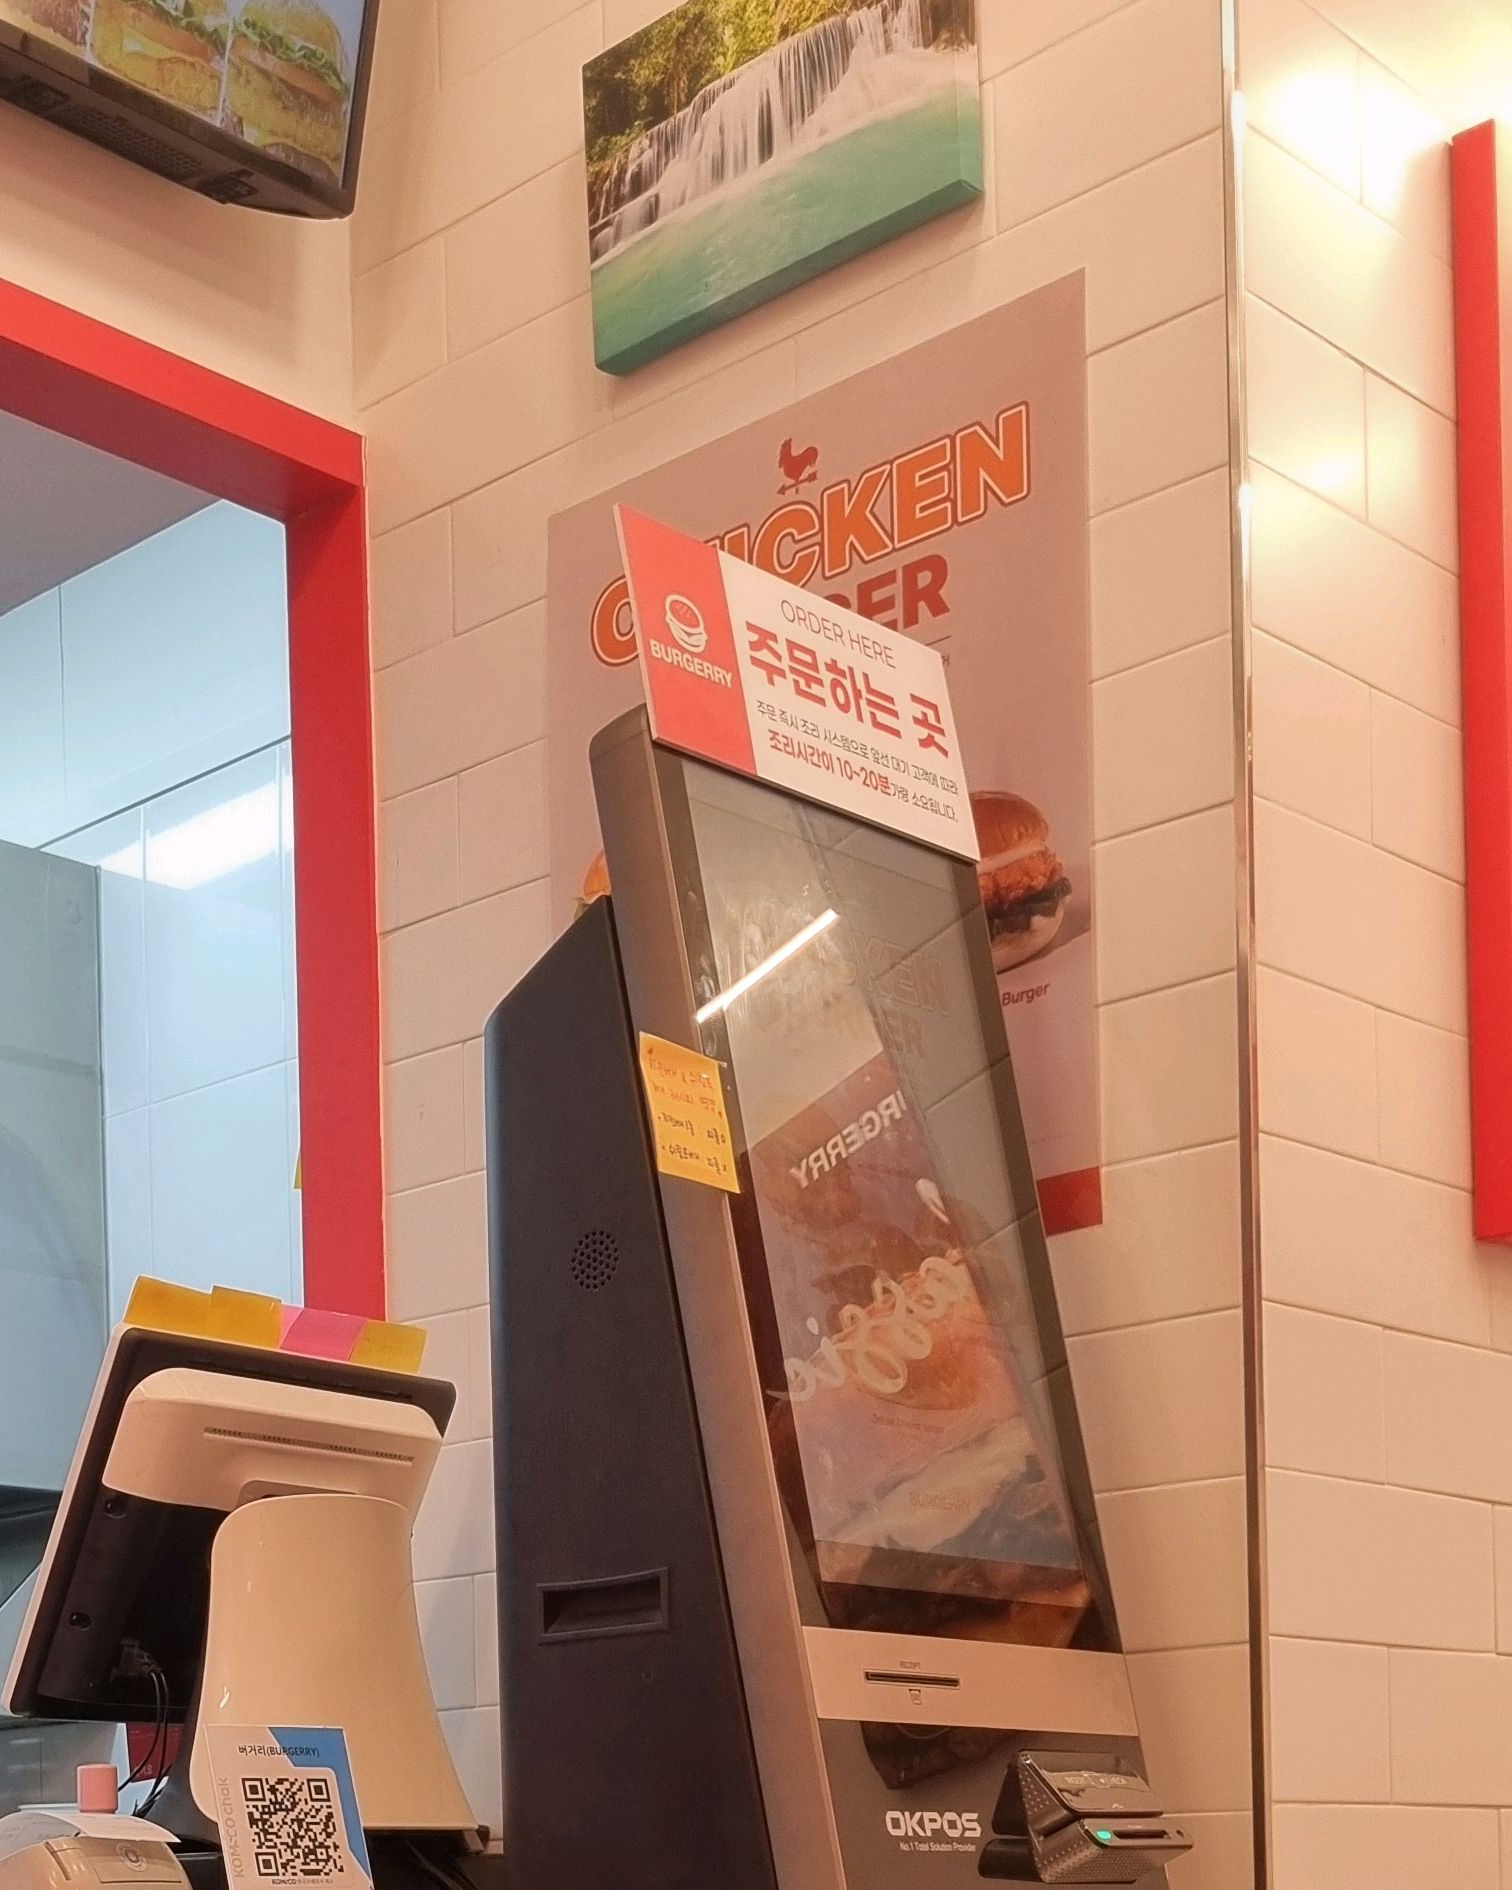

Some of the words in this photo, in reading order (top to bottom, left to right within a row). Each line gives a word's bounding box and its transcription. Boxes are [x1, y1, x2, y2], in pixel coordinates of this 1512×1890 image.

[590, 402, 1030, 667] CCKEN
[780, 599, 844, 648] ORDER
[849, 634, 896, 669] HERE
[649, 638, 732, 688] BURGERRY
[744, 620, 903, 740] 주문하는
[910, 692, 949, 759] 곳
[756, 700, 777, 721] 주문
[779, 709, 798, 730] 즉시
[801, 718, 821, 740] 조리
[823, 727, 870, 760] 시스템으로
[891, 756, 910, 776] 대기
[768, 728, 834, 774] 조리시간이
[1002, 983, 1050, 1007] Burger
[238, 1745, 320, 1758] 버거리(BURGERRY)
[885, 1810, 982, 1838] OKPOS
[915, 1842, 930, 1851] Total
[930, 1843, 953, 1852] Solution
[953, 1844, 976, 1852] Provider
